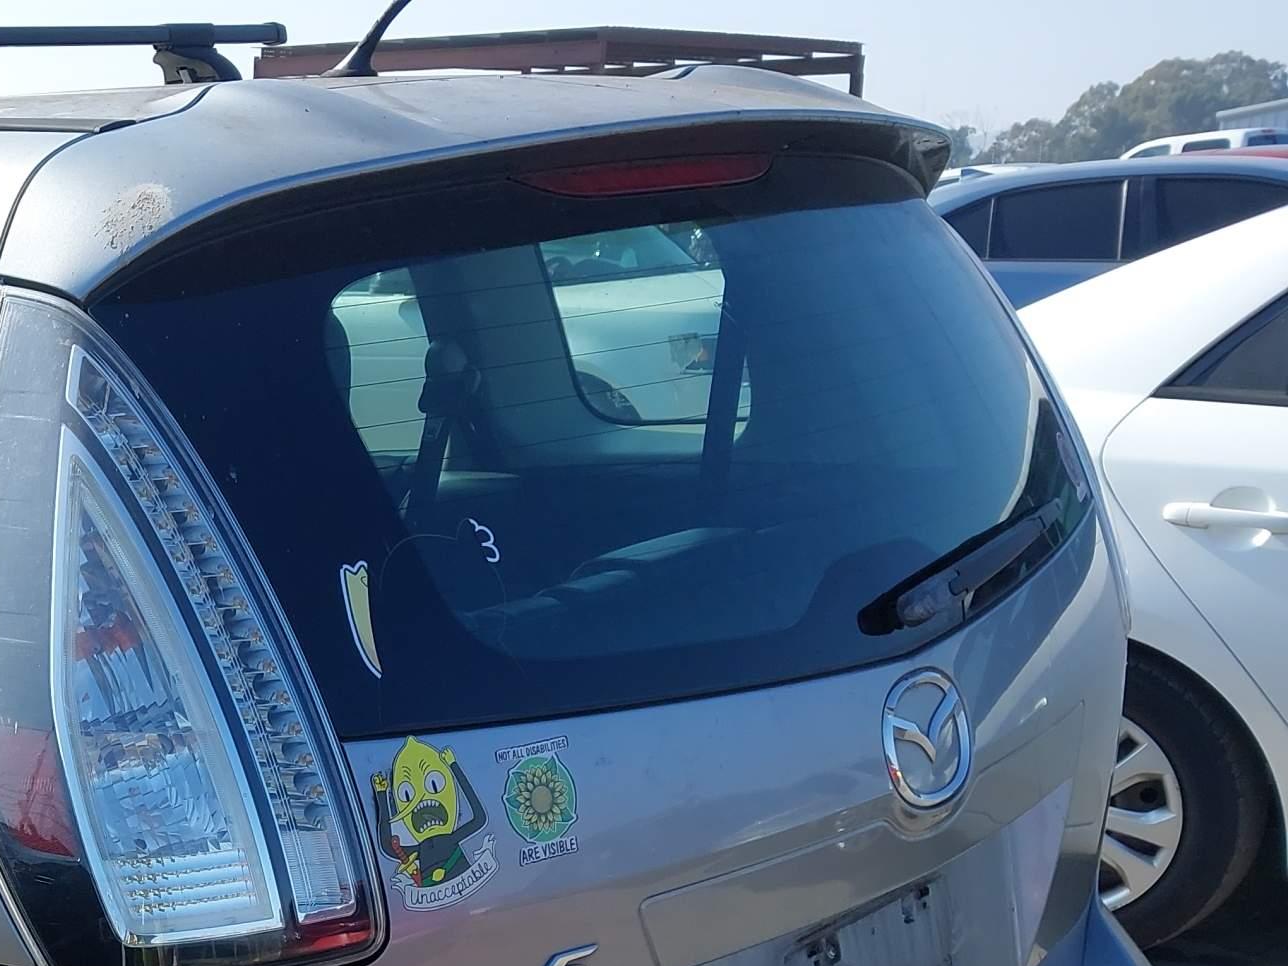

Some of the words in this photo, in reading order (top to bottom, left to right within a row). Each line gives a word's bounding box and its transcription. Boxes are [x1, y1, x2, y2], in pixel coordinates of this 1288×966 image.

[498, 751, 511, 762] NOT
[512, 748, 524, 759] ALL
[525, 739, 566, 756] DISABILITIES
[521, 848, 541, 863] ARE
[542, 839, 576, 858] VISIBLE
[410, 859, 493, 906] Unacceptable
